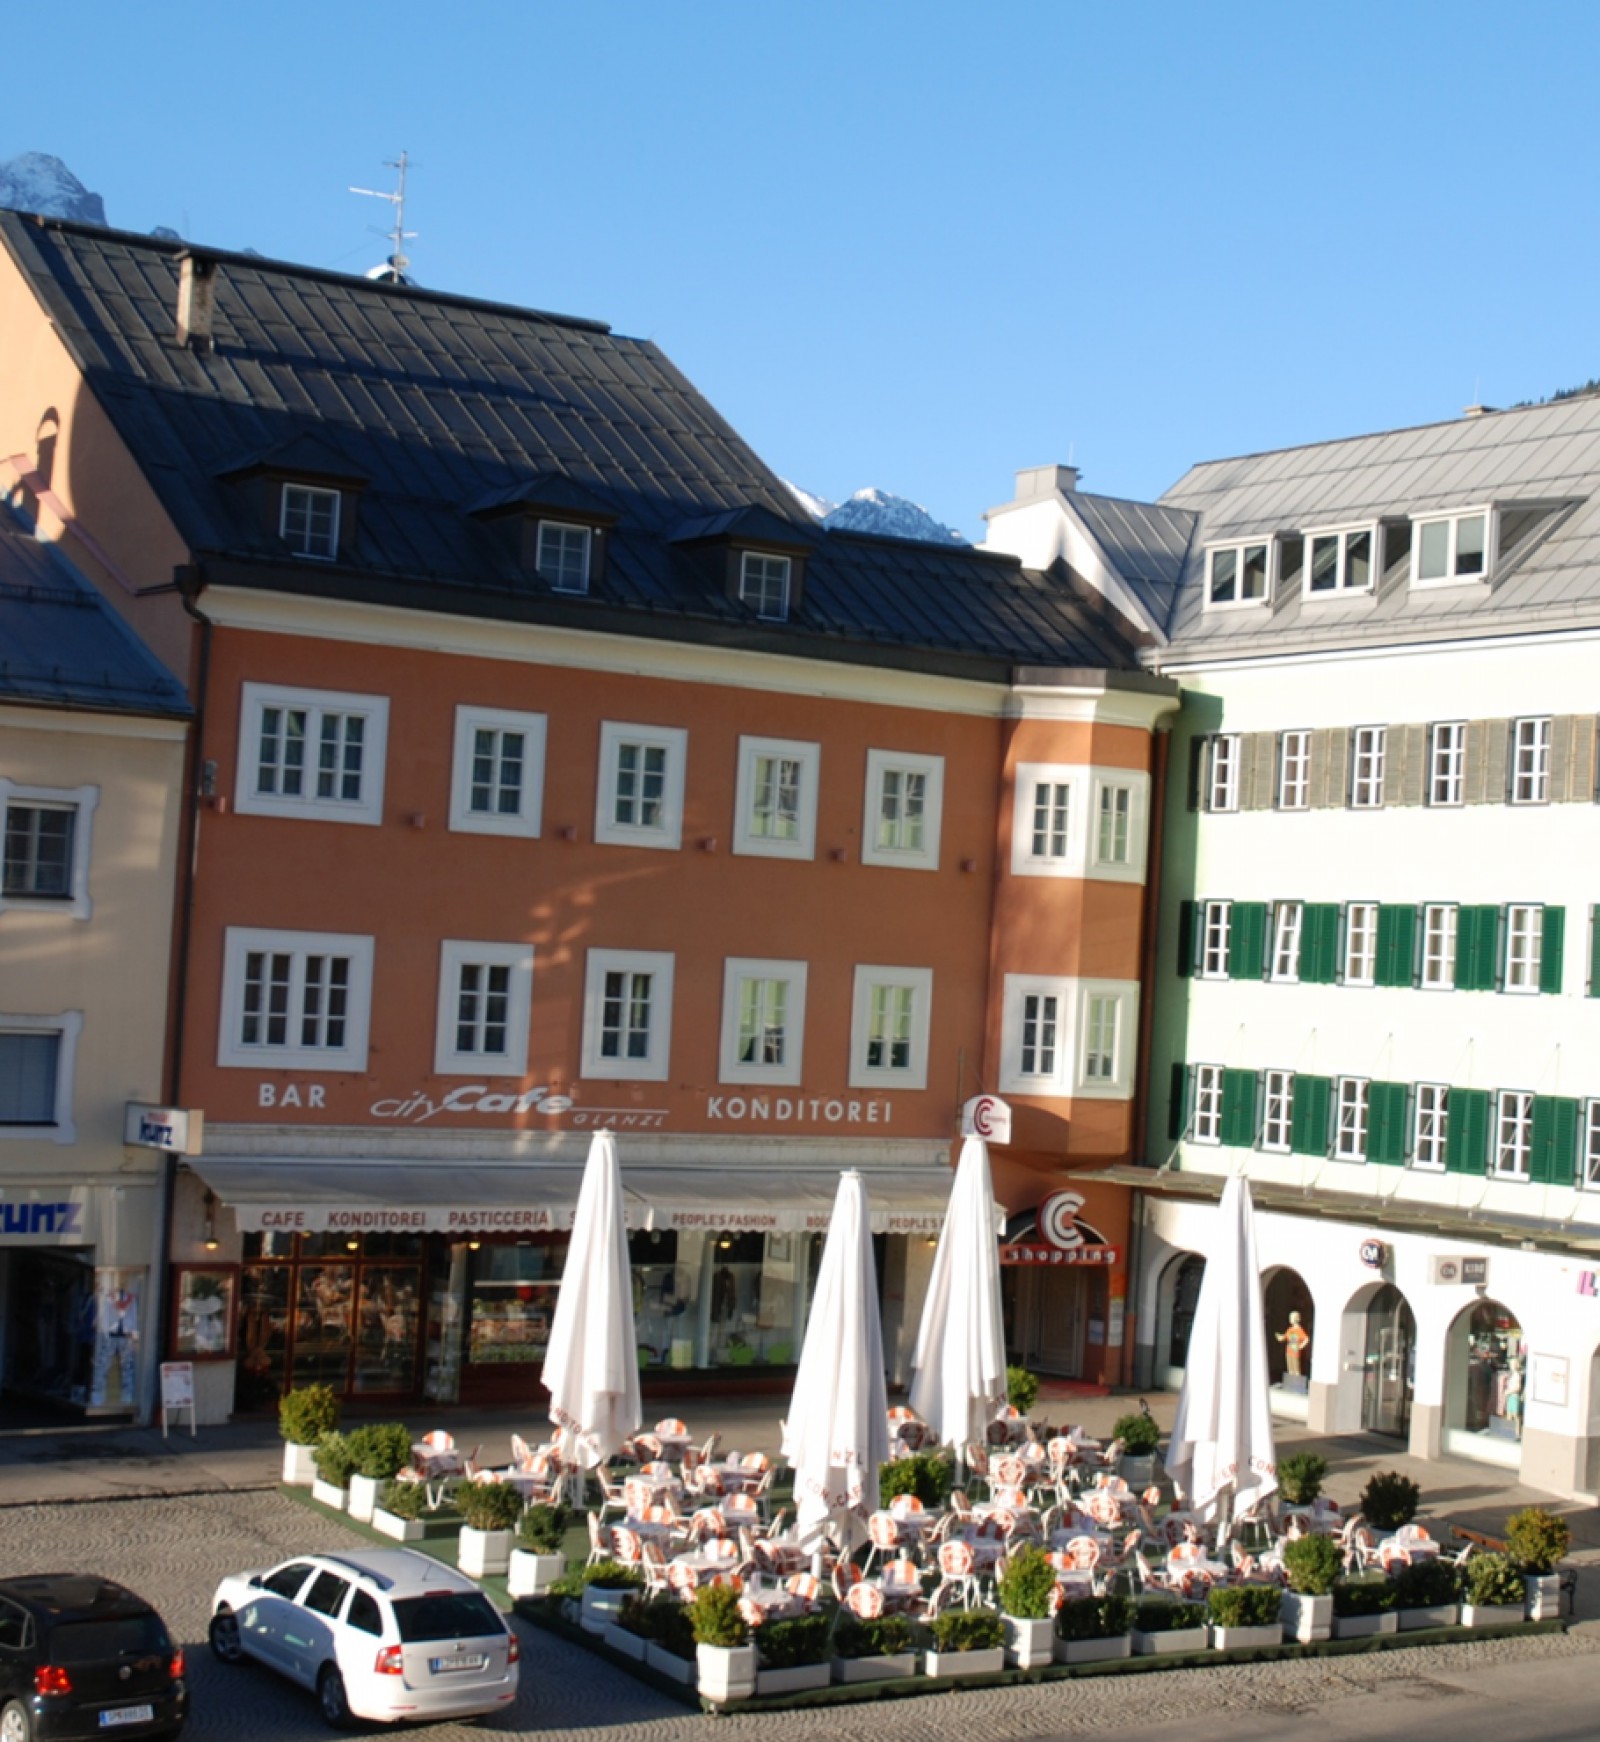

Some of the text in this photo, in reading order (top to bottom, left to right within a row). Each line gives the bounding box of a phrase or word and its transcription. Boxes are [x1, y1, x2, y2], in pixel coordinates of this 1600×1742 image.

[259, 1083, 326, 1108] BAR
[707, 1097, 892, 1123] KONDITOREI
[573, 1113, 664, 1127] GLANZL
[139, 1115, 173, 1146] kunz
[0, 1203, 82, 1233] unz
[261, 1210, 548, 1227] CAFE KONDITOREI PASTICCERIA
[672, 1212, 777, 1228] PEOPLE'S FASHION
[889, 1216, 939, 1229] PEOPLE'S
[1008, 1247, 1118, 1265] shopping
